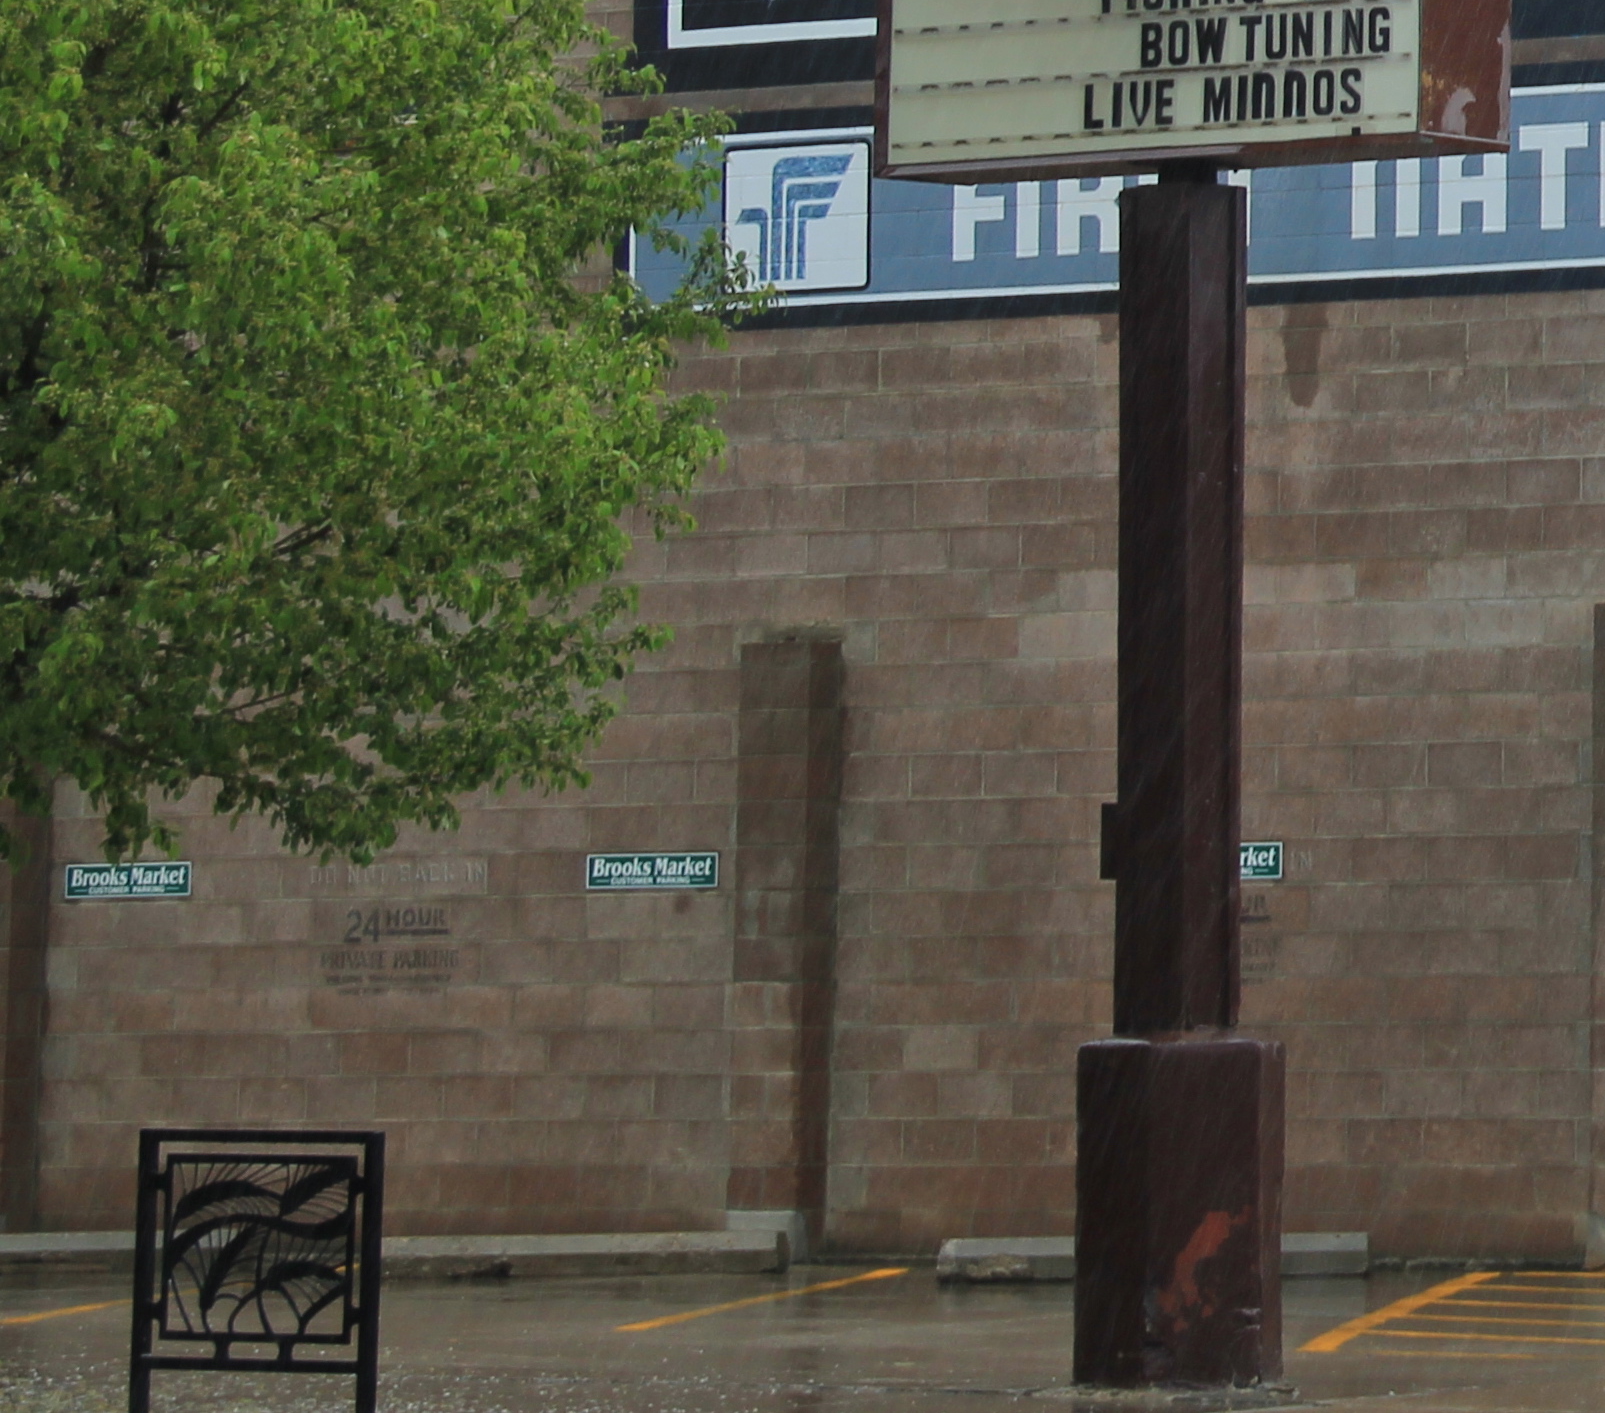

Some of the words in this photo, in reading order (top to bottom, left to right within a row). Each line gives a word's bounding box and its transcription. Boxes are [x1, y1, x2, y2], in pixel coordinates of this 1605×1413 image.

[1141, 15, 1234, 71] BOW
[1239, 6, 1393, 60] TUNING
[1083, 87, 1174, 131] LIVE
[1203, 68, 1363, 121] MINNOS
[592, 856, 651, 877] Brooks
[654, 856, 712, 876] Market
[1240, 846, 1276, 867] rket
[71, 866, 129, 887] Brooks
[130, 865, 187, 886] Market
[610, 876, 653, 885] CUSTOMER
[656, 875, 691, 884] PARKING
[88, 886, 130, 895] CUSTOMER
[132, 884, 165, 893] PARKING
[344, 907, 380, 943] 24
[386, 906, 447, 928] HOUR
